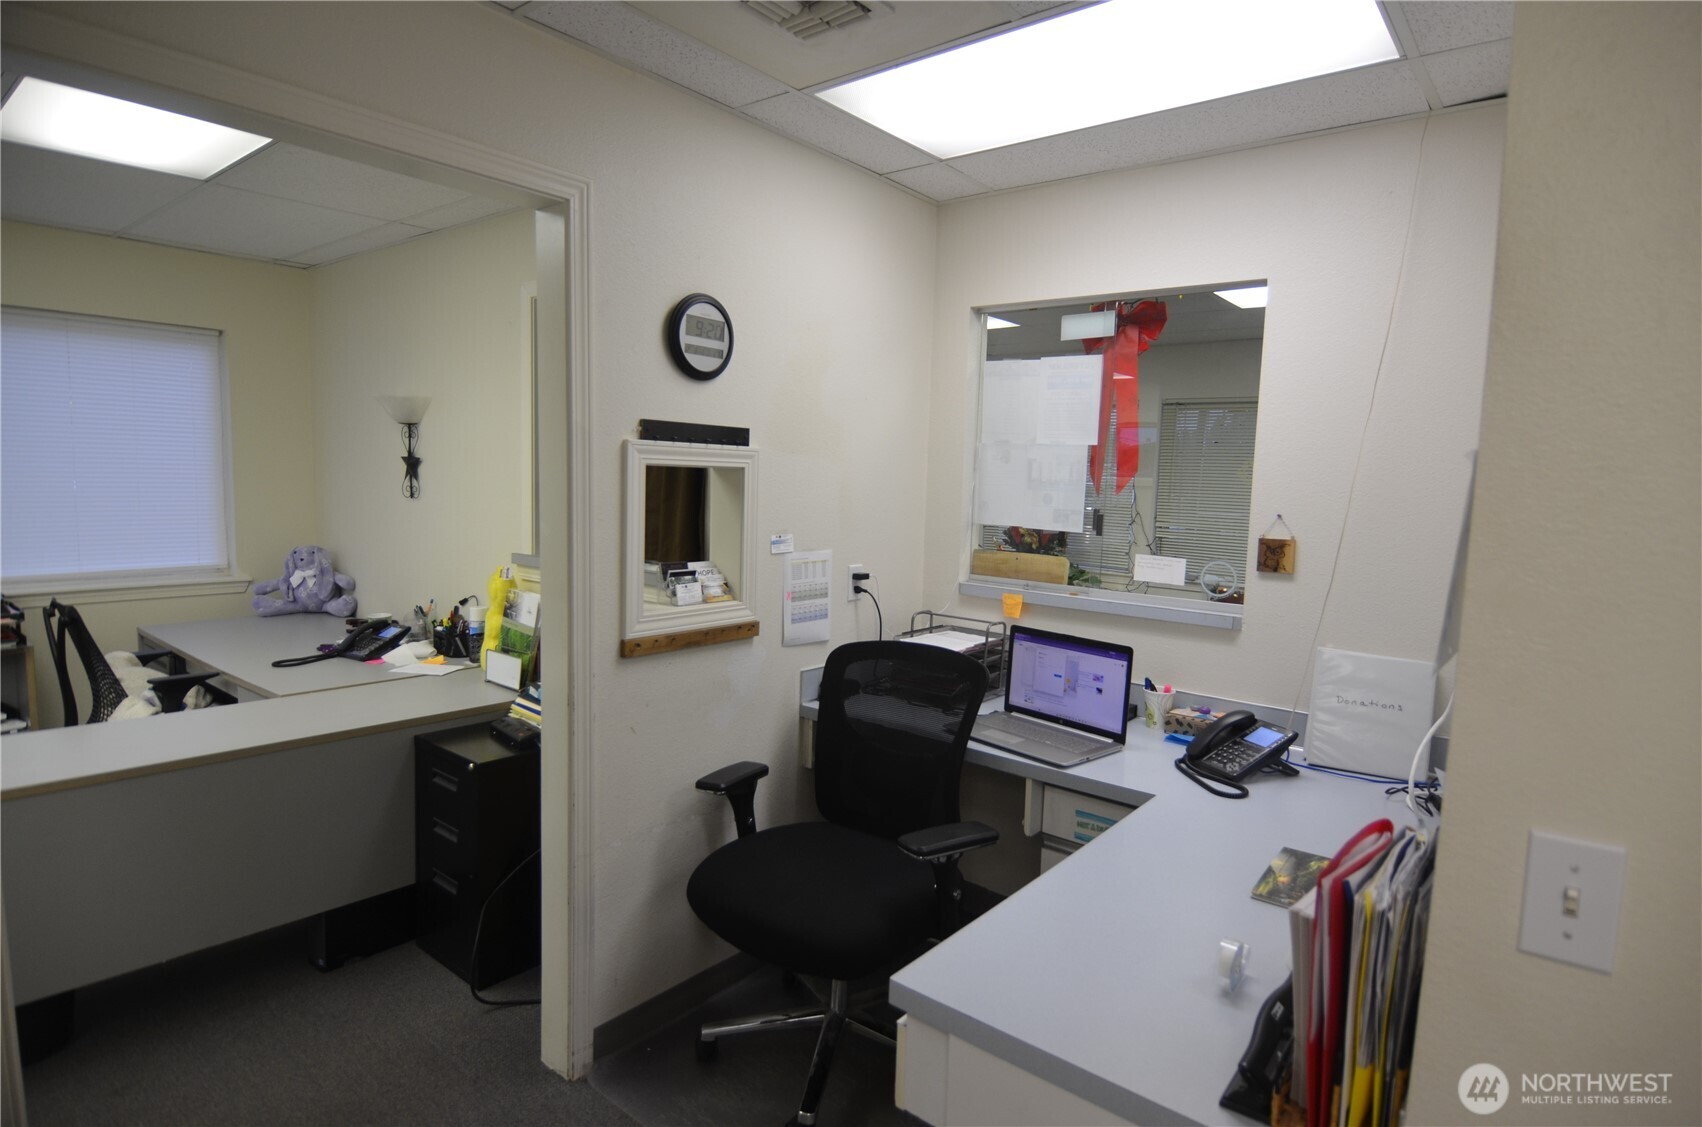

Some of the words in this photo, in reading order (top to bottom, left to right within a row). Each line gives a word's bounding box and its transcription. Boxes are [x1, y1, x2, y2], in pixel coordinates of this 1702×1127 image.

[695, 320, 723, 341] 9:20
[698, 569, 715, 577] HOPE
[1336, 695, 1403, 711] Donations
